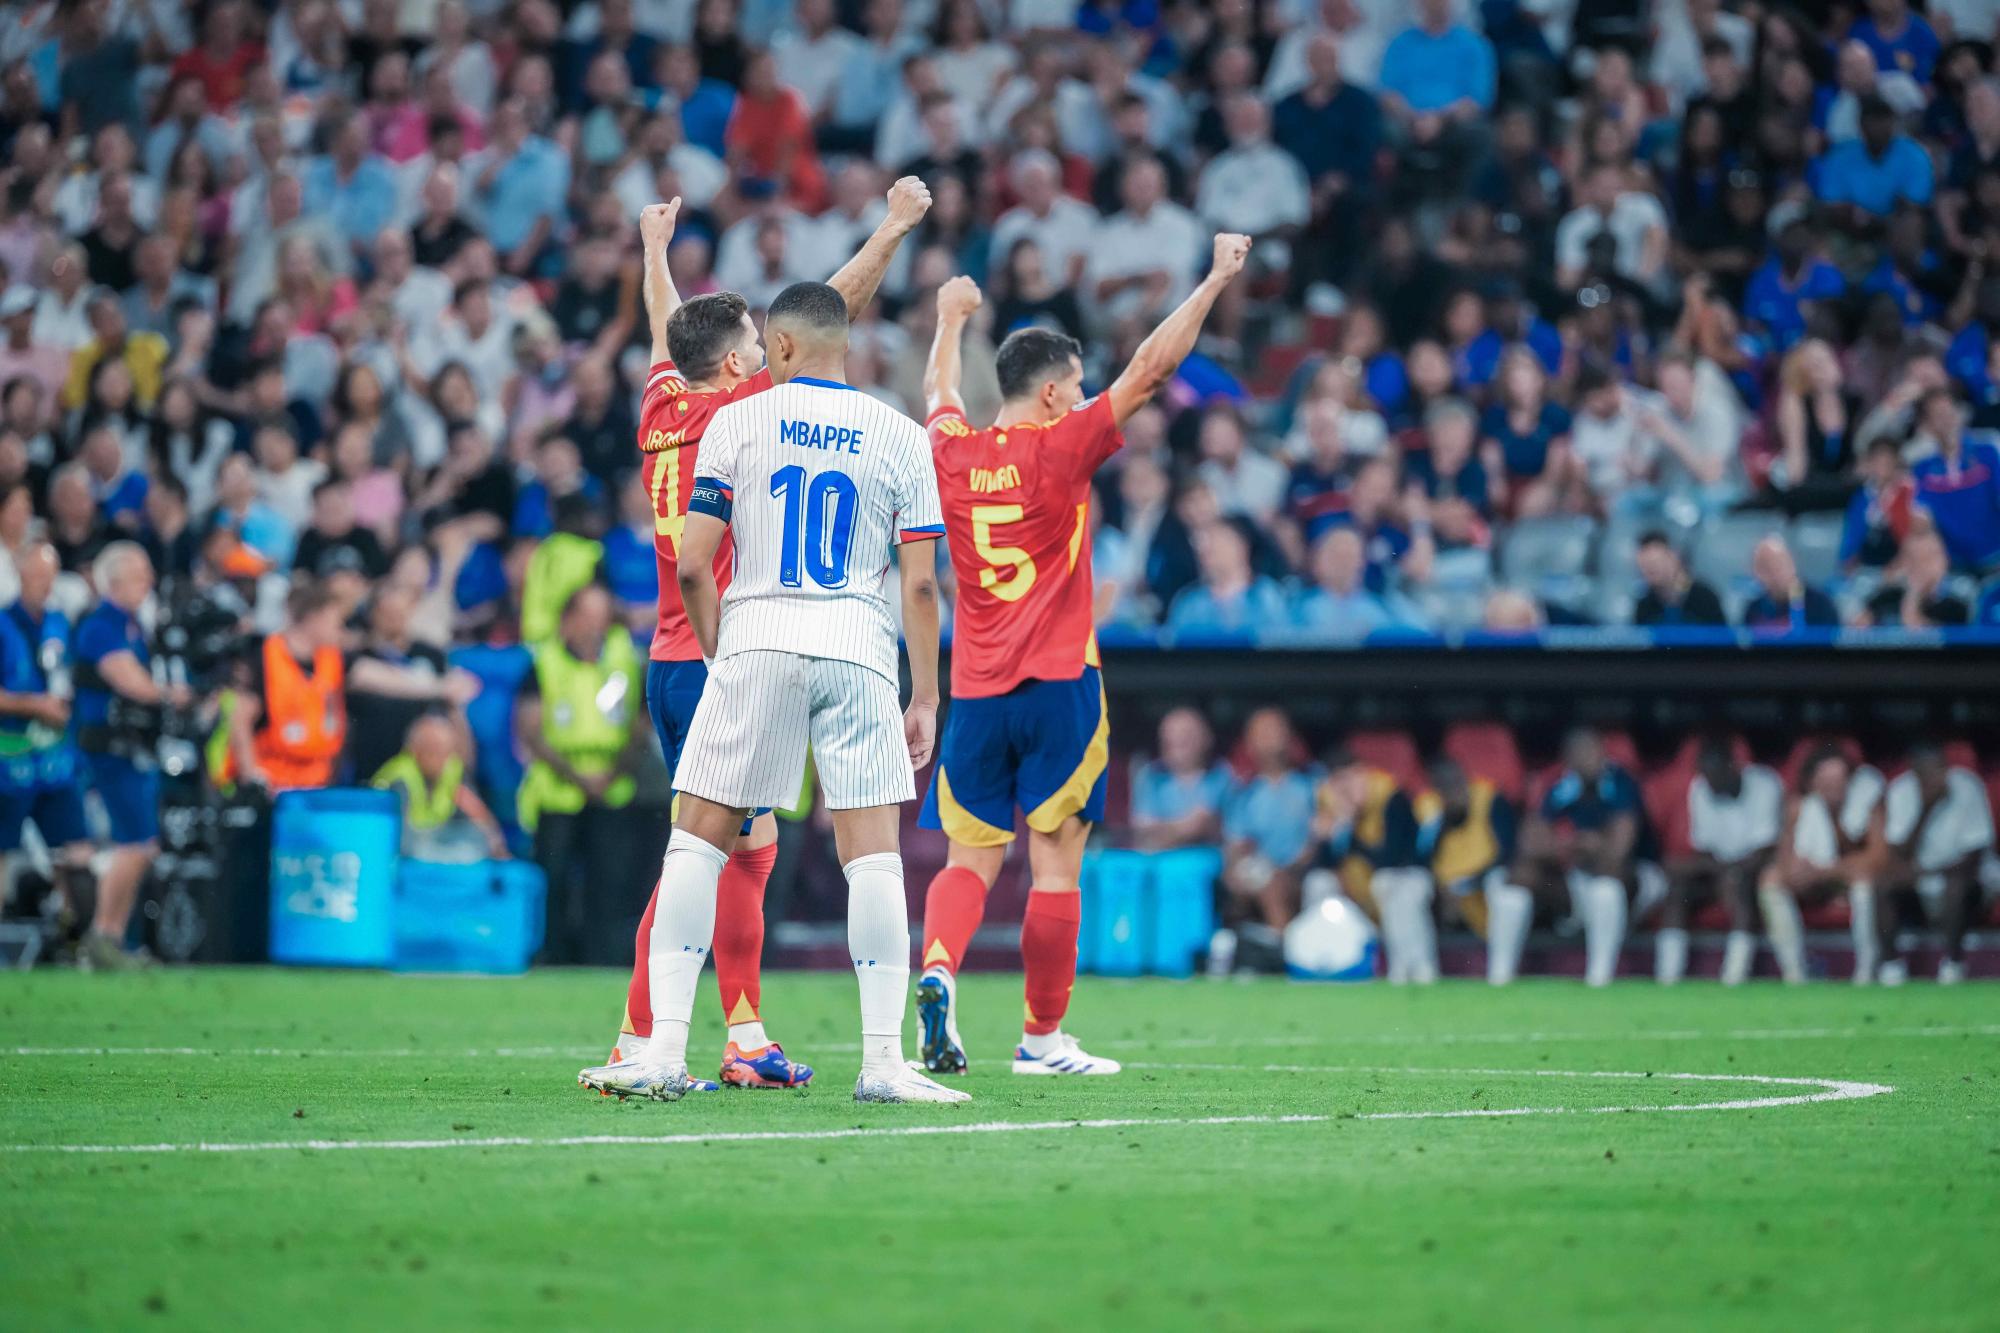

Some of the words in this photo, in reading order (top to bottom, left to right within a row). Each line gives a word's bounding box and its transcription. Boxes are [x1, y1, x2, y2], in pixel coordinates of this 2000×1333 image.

[780, 419, 864, 455] MBAPPE
[651, 446, 686, 560] 4
[692, 489, 720, 501] ESPECT
[770, 464, 860, 590] 10
[971, 504, 1037, 602] 5
